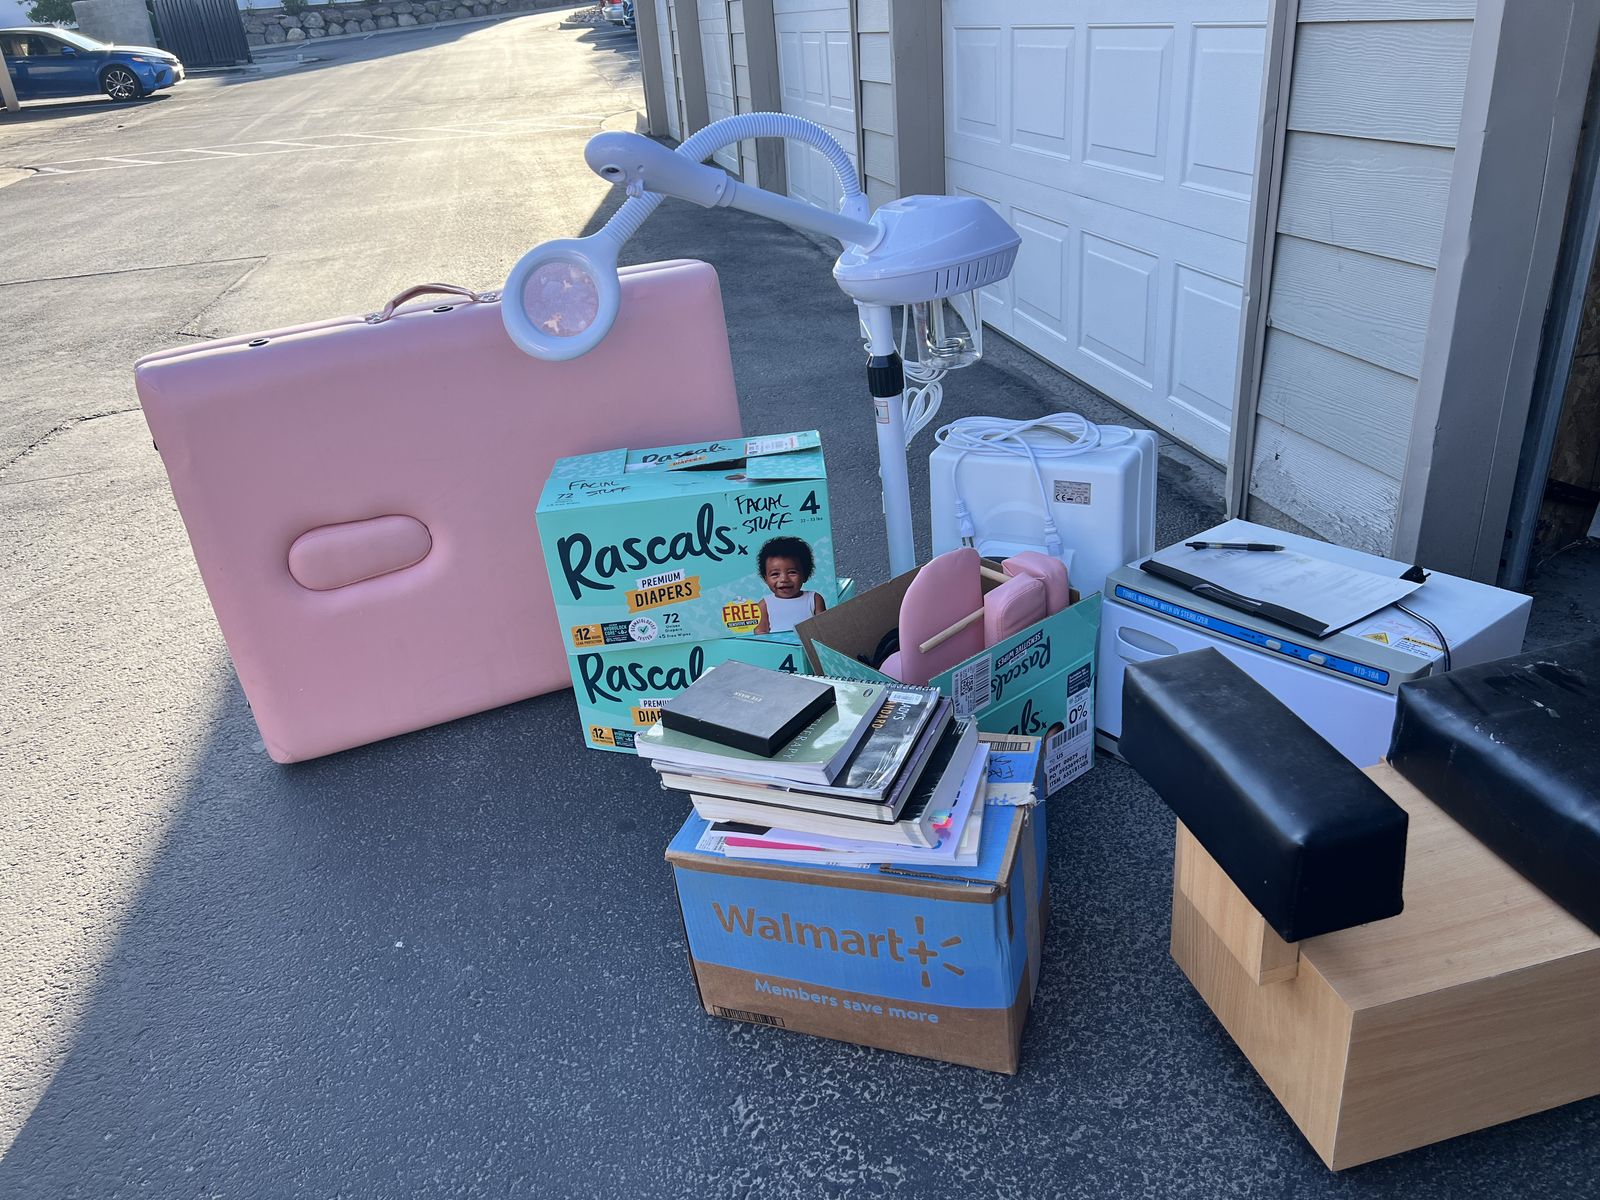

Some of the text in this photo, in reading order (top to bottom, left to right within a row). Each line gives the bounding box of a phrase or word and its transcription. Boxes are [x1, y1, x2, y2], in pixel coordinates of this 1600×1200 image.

[569, 480, 619, 490] FACIAL
[586, 486, 631, 496] STUFF
[735, 494, 789, 514] FACIAL
[799, 490, 820, 514] 4
[742, 512, 793, 534] STUFF
[557, 503, 736, 600] Rascals
[641, 572, 681, 588] PREMIUM
[635, 582, 692, 607] DIAPERS
[663, 613, 680, 624] 72
[722, 603, 760, 622] FREE
[1181, 608, 1209, 625] STERILIZER
[576, 628, 591, 640] 12
[779, 654, 798, 673] 4
[997, 650, 1016, 667] WIPES
[578, 646, 704, 704] Rascal
[991, 636, 1051, 701] Rascals
[638, 710, 662, 722] DIAP
[1069, 701, 1088, 725] 0%
[593, 728, 604, 739] 12
[1056, 752, 1064, 760] US
[1049, 763, 1061, 773] DEPT
[1050, 777, 1061, 787] ITEM
[753, 978, 939, 1024] Members save more
